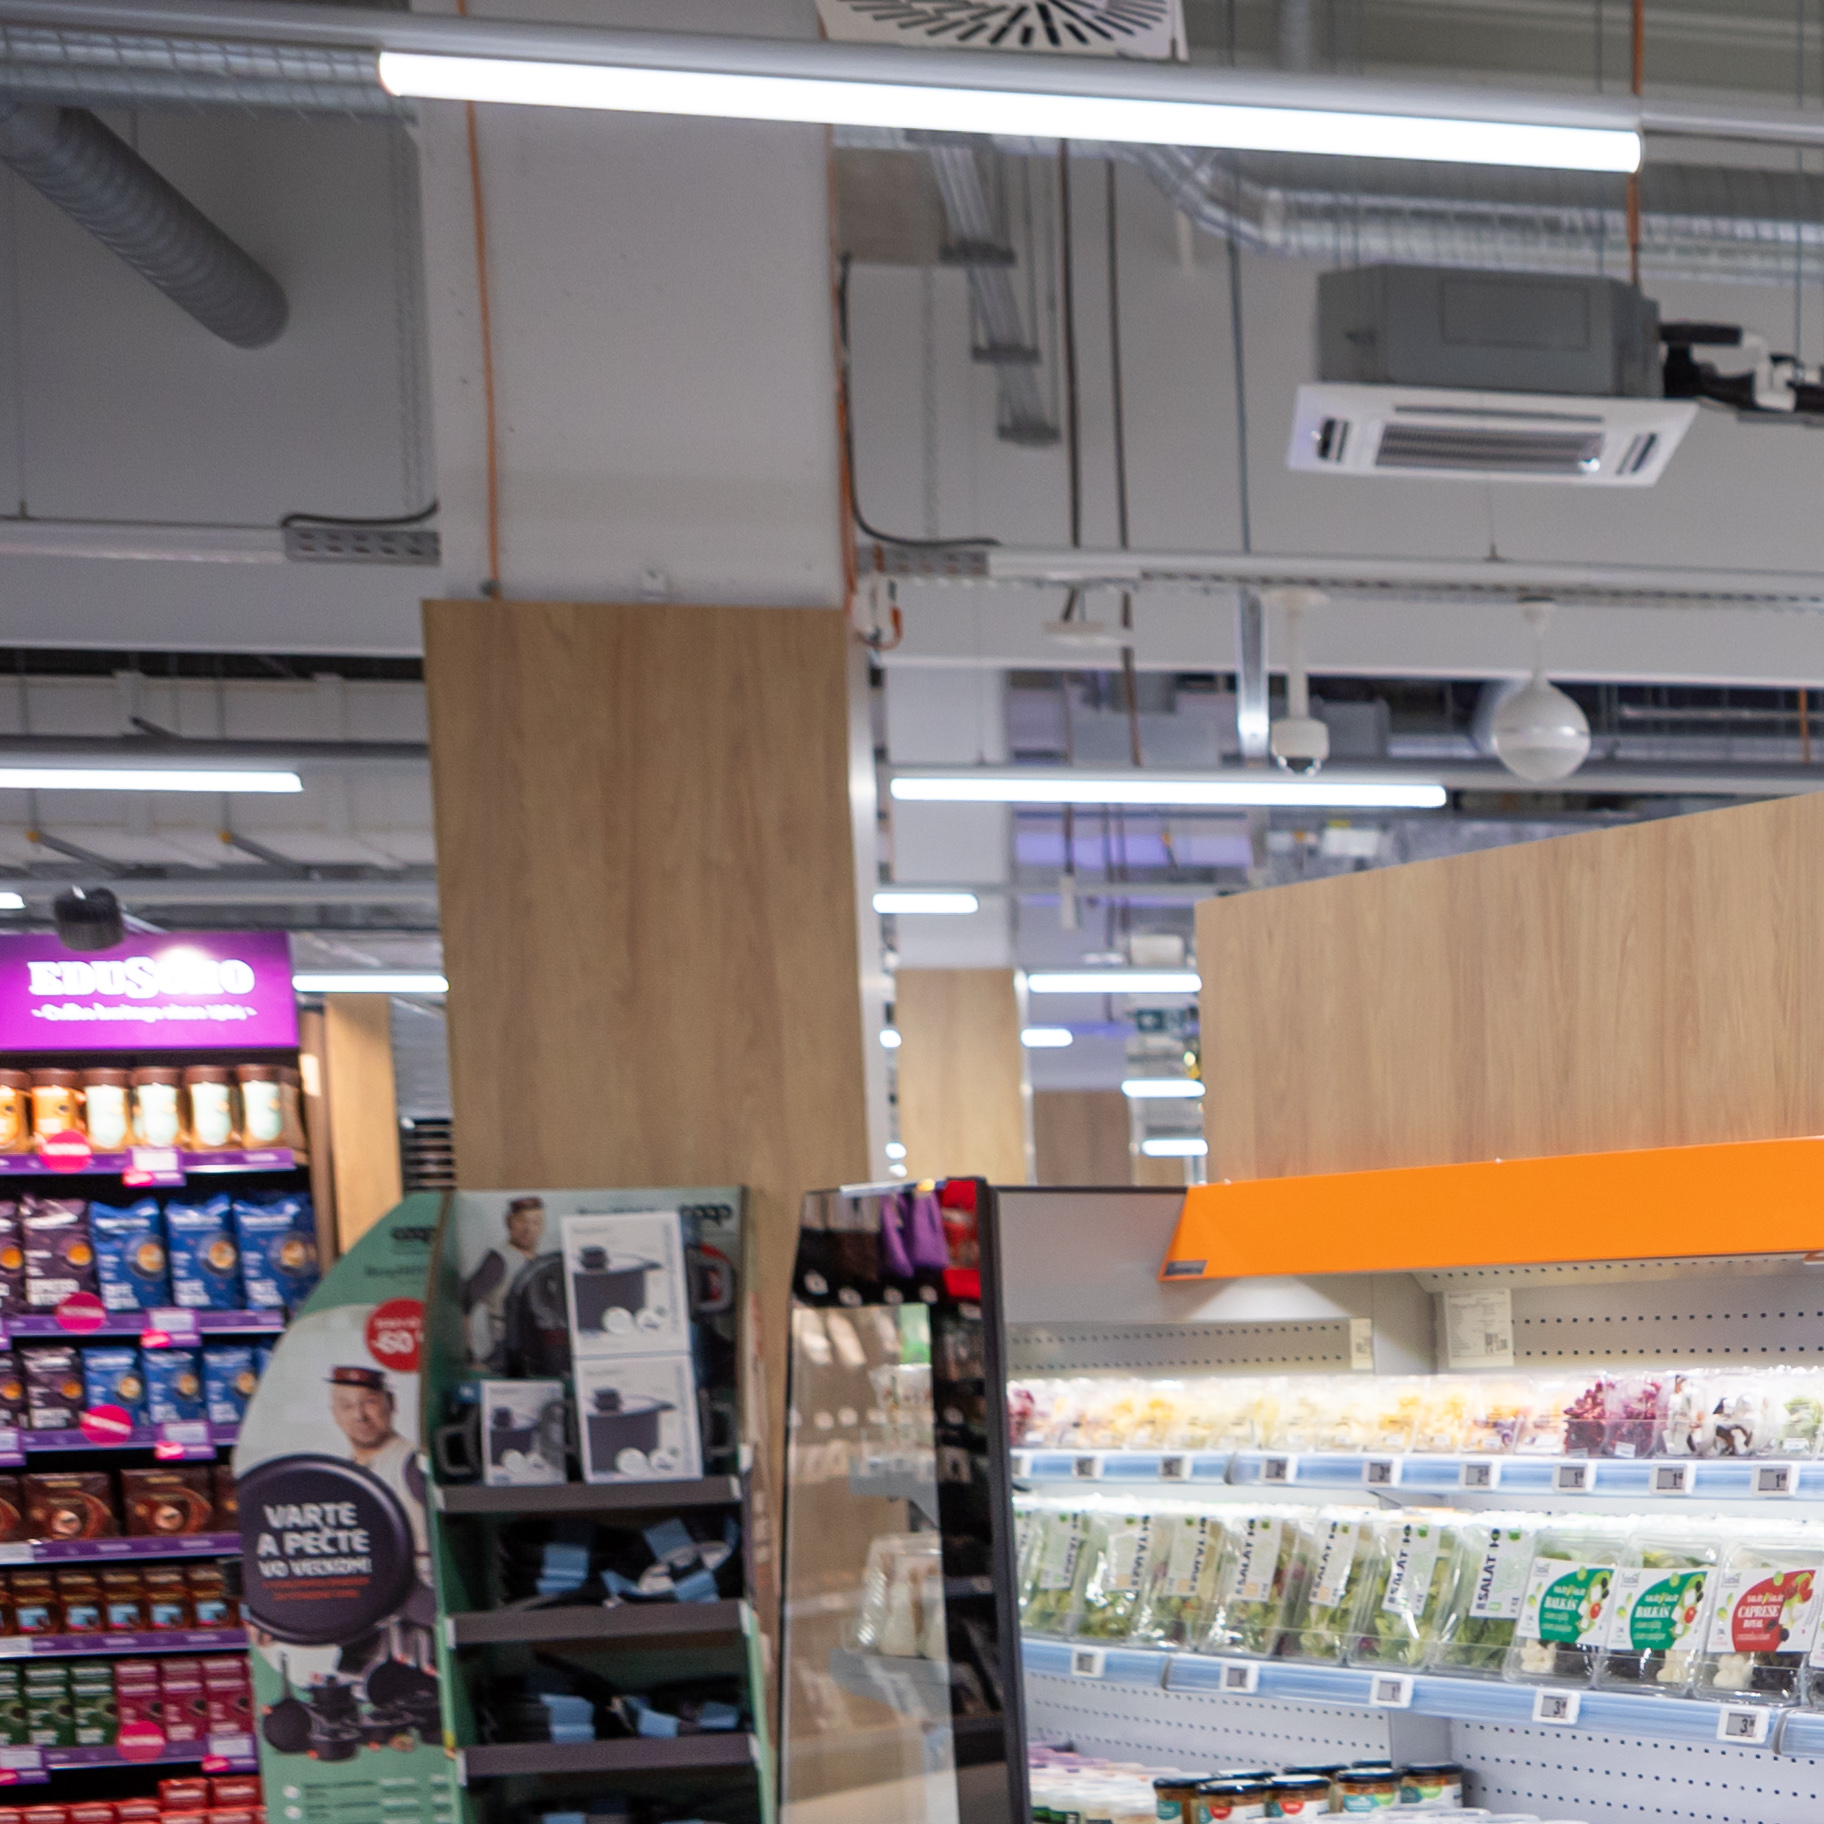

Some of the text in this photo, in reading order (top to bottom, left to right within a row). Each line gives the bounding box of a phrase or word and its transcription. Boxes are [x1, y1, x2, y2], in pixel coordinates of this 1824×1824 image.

[27, 955, 255, 999] EDUSO
[263, 1502, 358, 1529] VARTE
[257, 1532, 281, 1558] A
[1476, 1553, 1498, 1602] SALAT
[1737, 1604, 1782, 1619] CAPRESE
